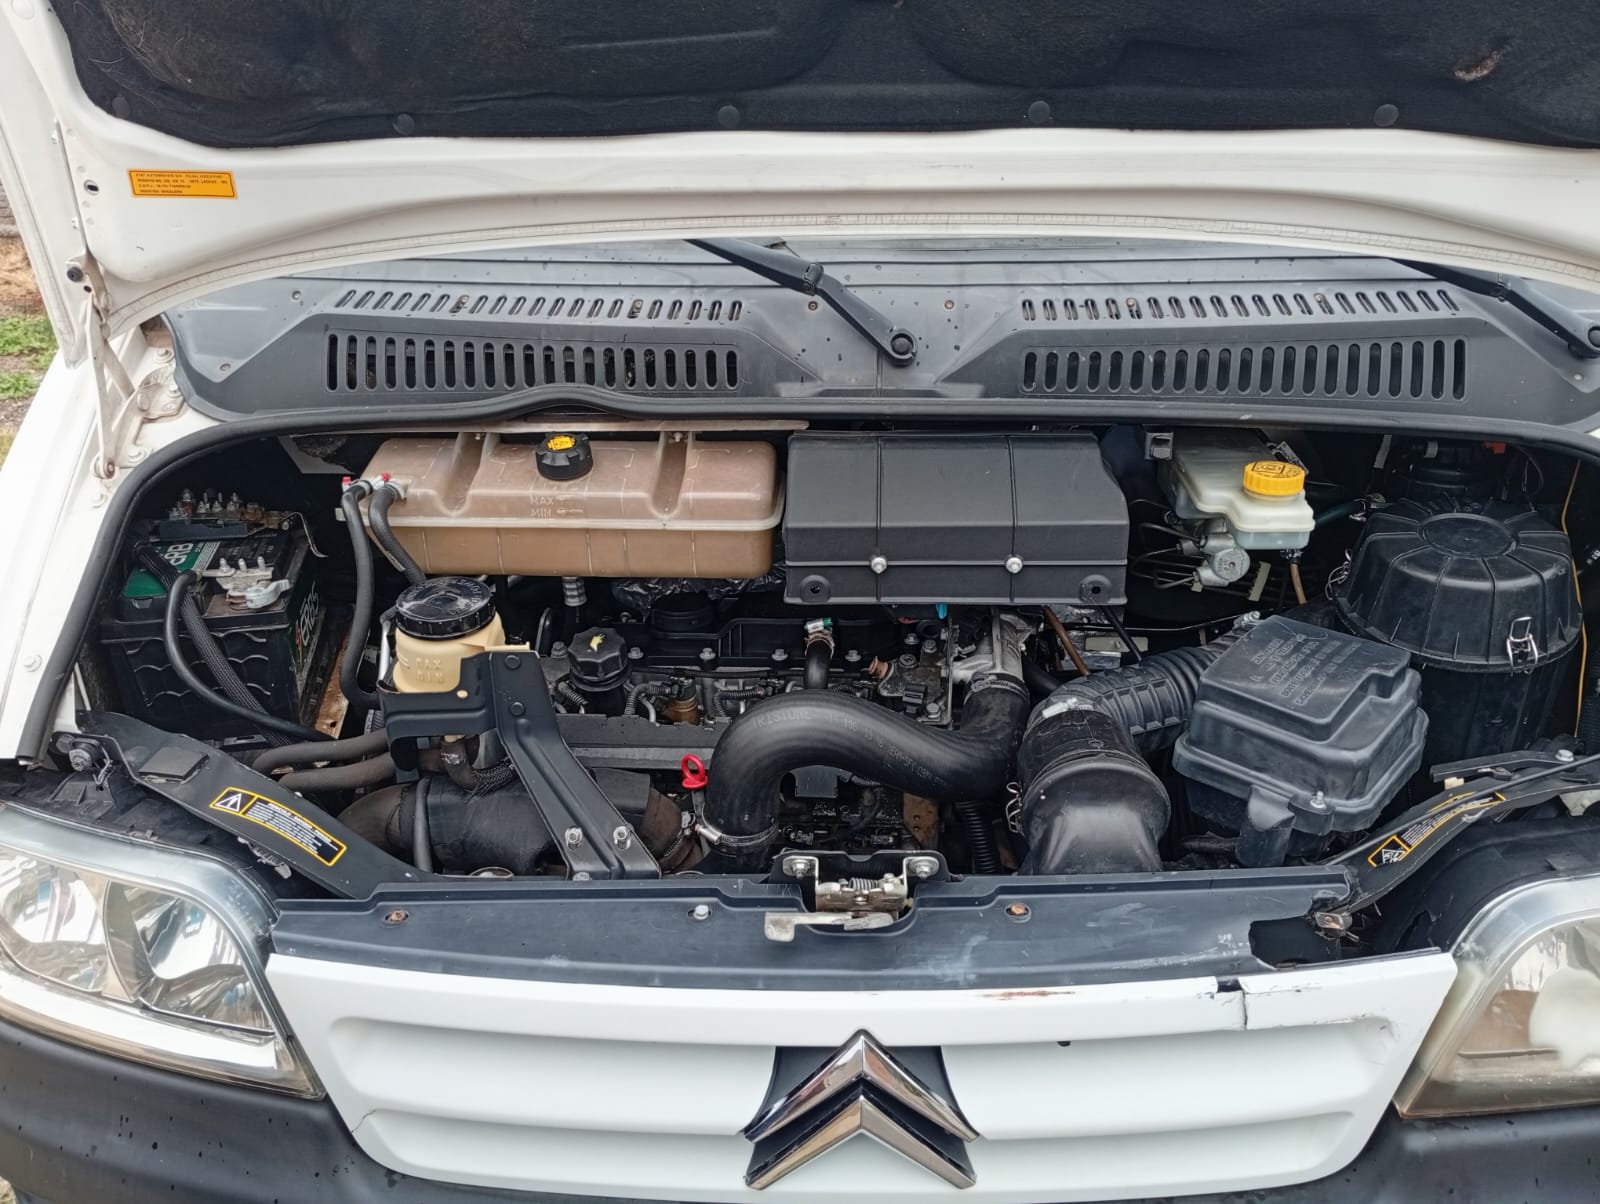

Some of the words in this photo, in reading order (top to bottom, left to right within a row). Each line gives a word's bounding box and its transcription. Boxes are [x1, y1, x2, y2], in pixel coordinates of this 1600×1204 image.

[529, 496, 554, 505] MAX
[530, 508, 552, 518] MIN
[416, 657, 441, 670] MAX
[417, 671, 444, 684] MIN
